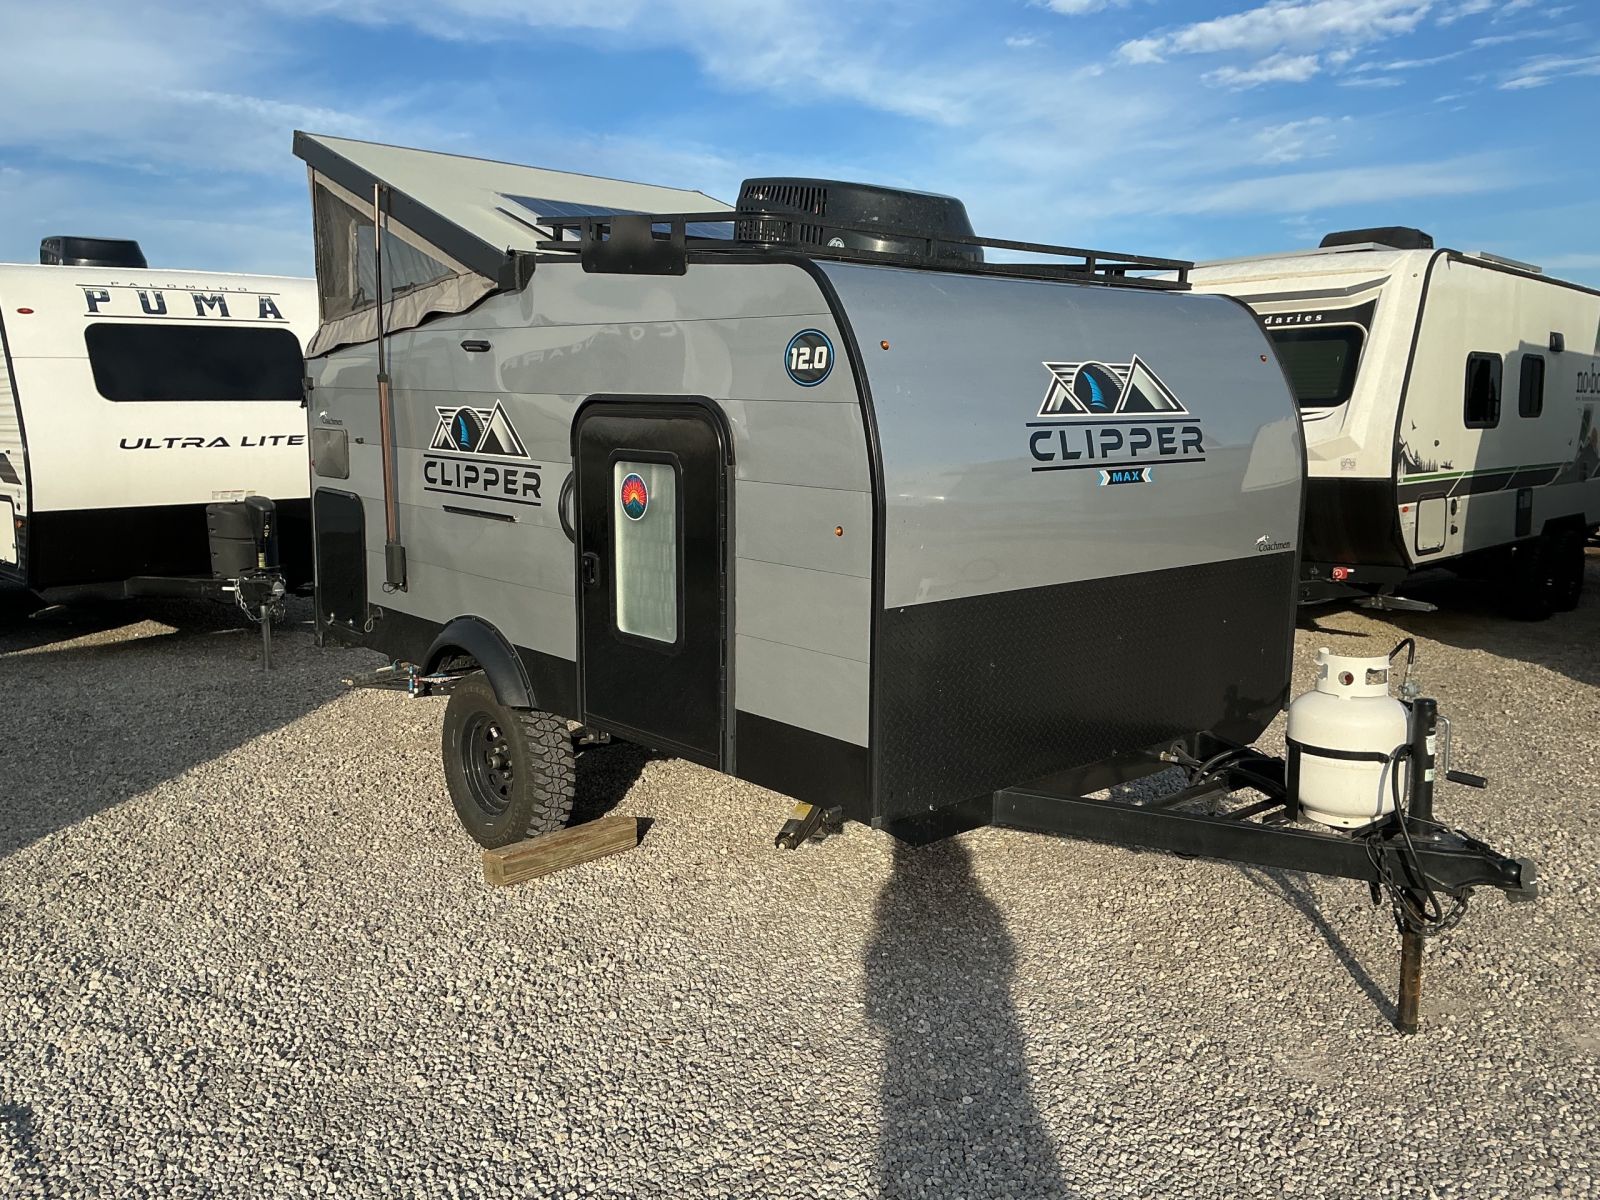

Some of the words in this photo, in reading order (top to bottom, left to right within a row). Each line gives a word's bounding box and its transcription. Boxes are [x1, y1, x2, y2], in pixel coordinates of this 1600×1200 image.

[83, 287, 285, 320] PUMA
[791, 346, 828, 370] 12.0
[119, 436, 231, 450] ULTRA
[240, 434, 306, 447] LITE
[1029, 426, 1206, 462] CLIPPER
[423, 460, 542, 499] CLIPPER
[1112, 470, 1140, 483] MAX
